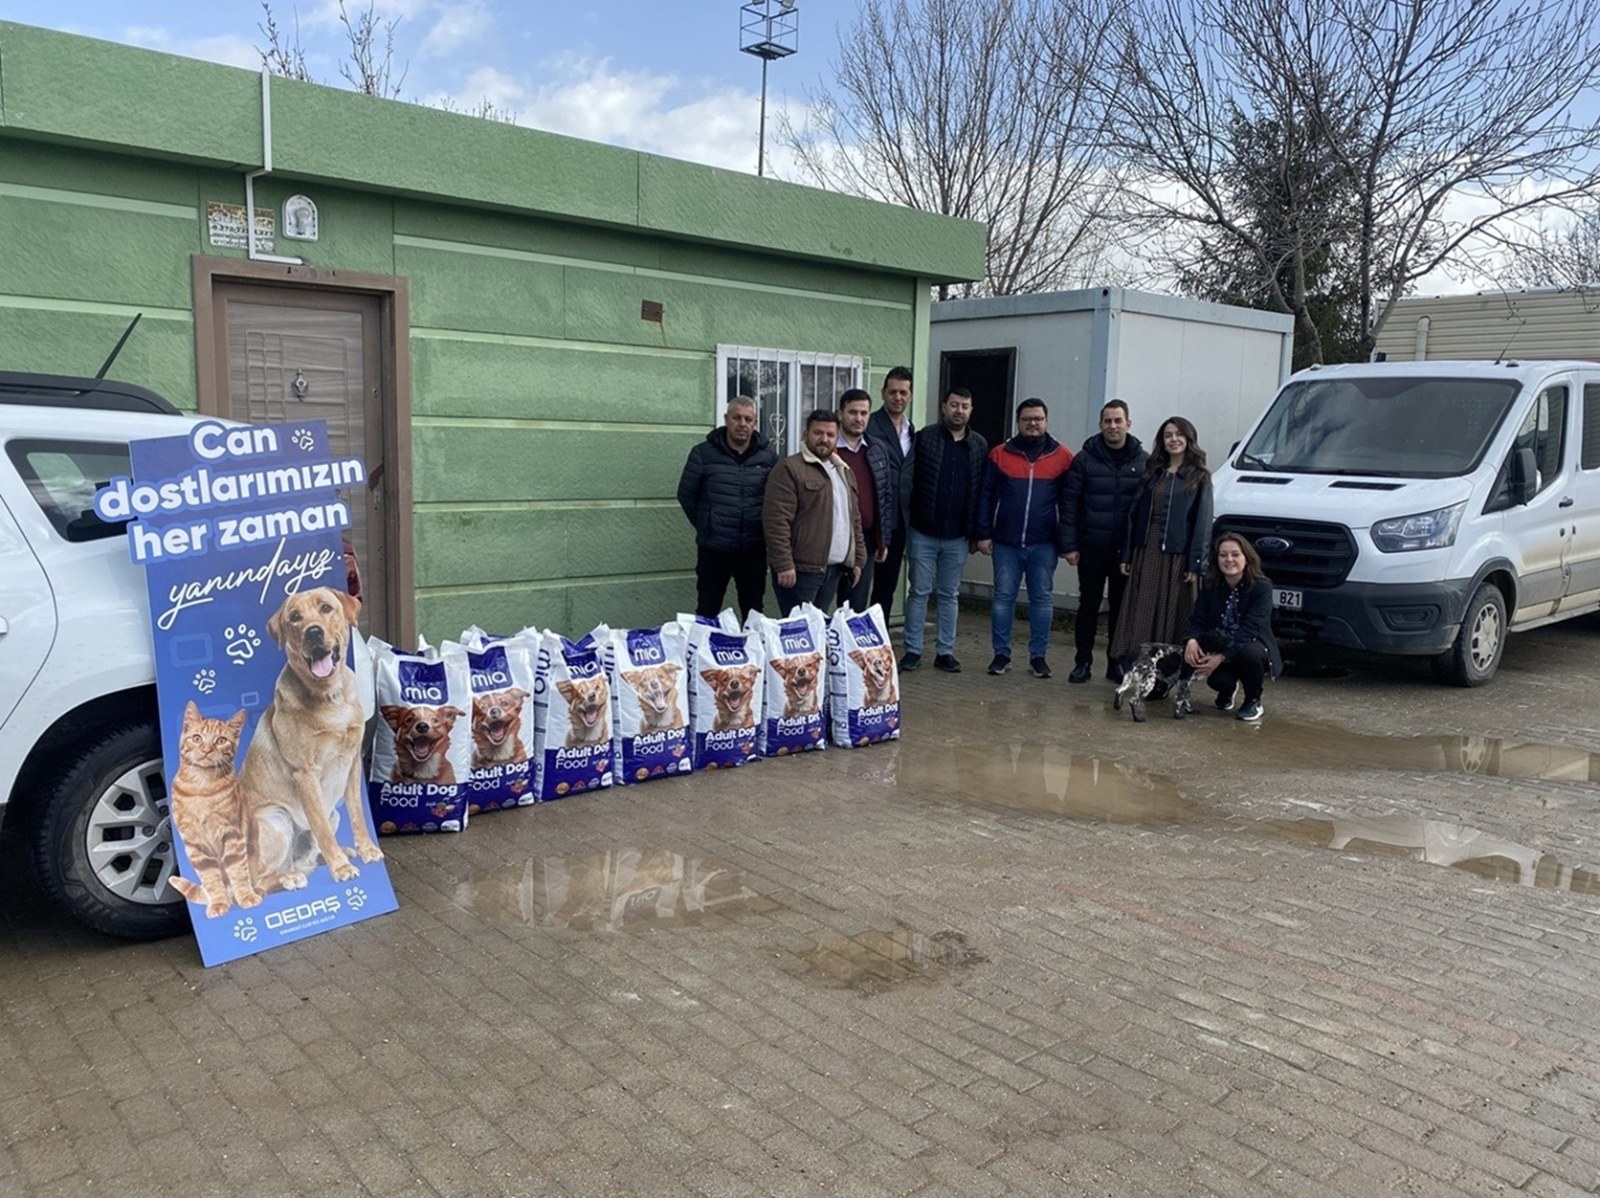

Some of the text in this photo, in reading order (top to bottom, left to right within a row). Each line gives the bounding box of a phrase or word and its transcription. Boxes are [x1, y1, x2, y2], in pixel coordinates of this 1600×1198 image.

[193, 424, 277, 459] Can
[99, 459, 364, 517] dostlarımızın
[133, 502, 348, 560] her zaman
[1280, 591, 1300, 606] 821
[858, 706, 884, 717] Adult
[777, 716, 807, 728] Adult
[857, 713, 882, 726] Food
[633, 728, 686, 746] Adult Dog
[705, 726, 756, 742] Adult Dog
[776, 725, 804, 736] Food
[633, 742, 664, 756] Food
[705, 739, 734, 751] Food
[555, 746, 592, 759] Adult
[505, 760, 529, 775] Dog
[555, 757, 588, 769] Food
[381, 782, 458, 797] Adult Dog
[380, 794, 419, 807] Food
